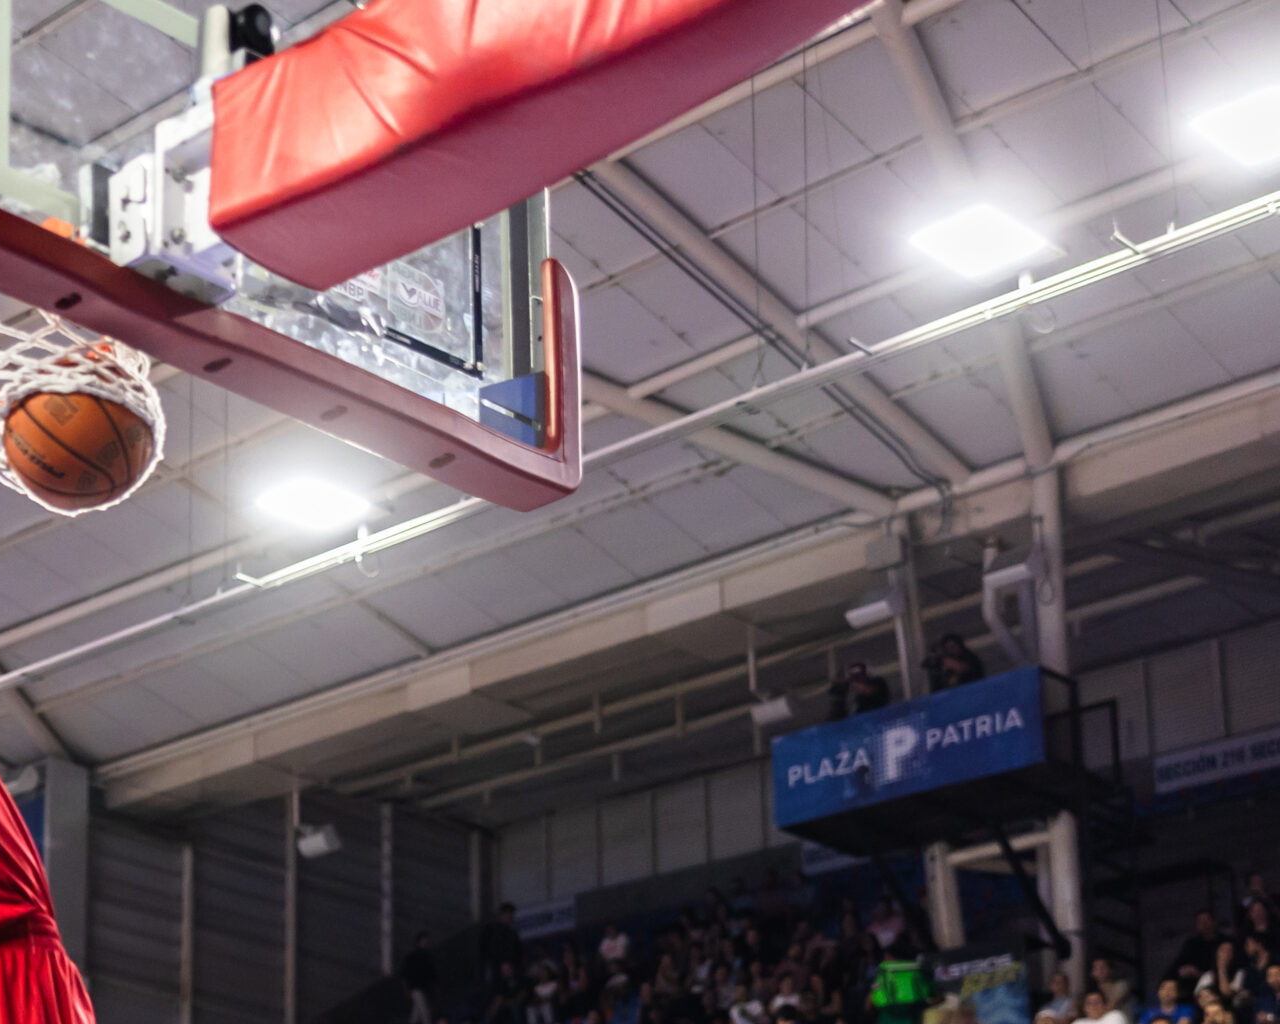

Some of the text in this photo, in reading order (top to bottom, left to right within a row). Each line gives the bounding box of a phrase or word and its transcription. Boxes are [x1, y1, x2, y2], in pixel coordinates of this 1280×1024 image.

[788, 707, 1024, 788] PLAZA P PATRIA
